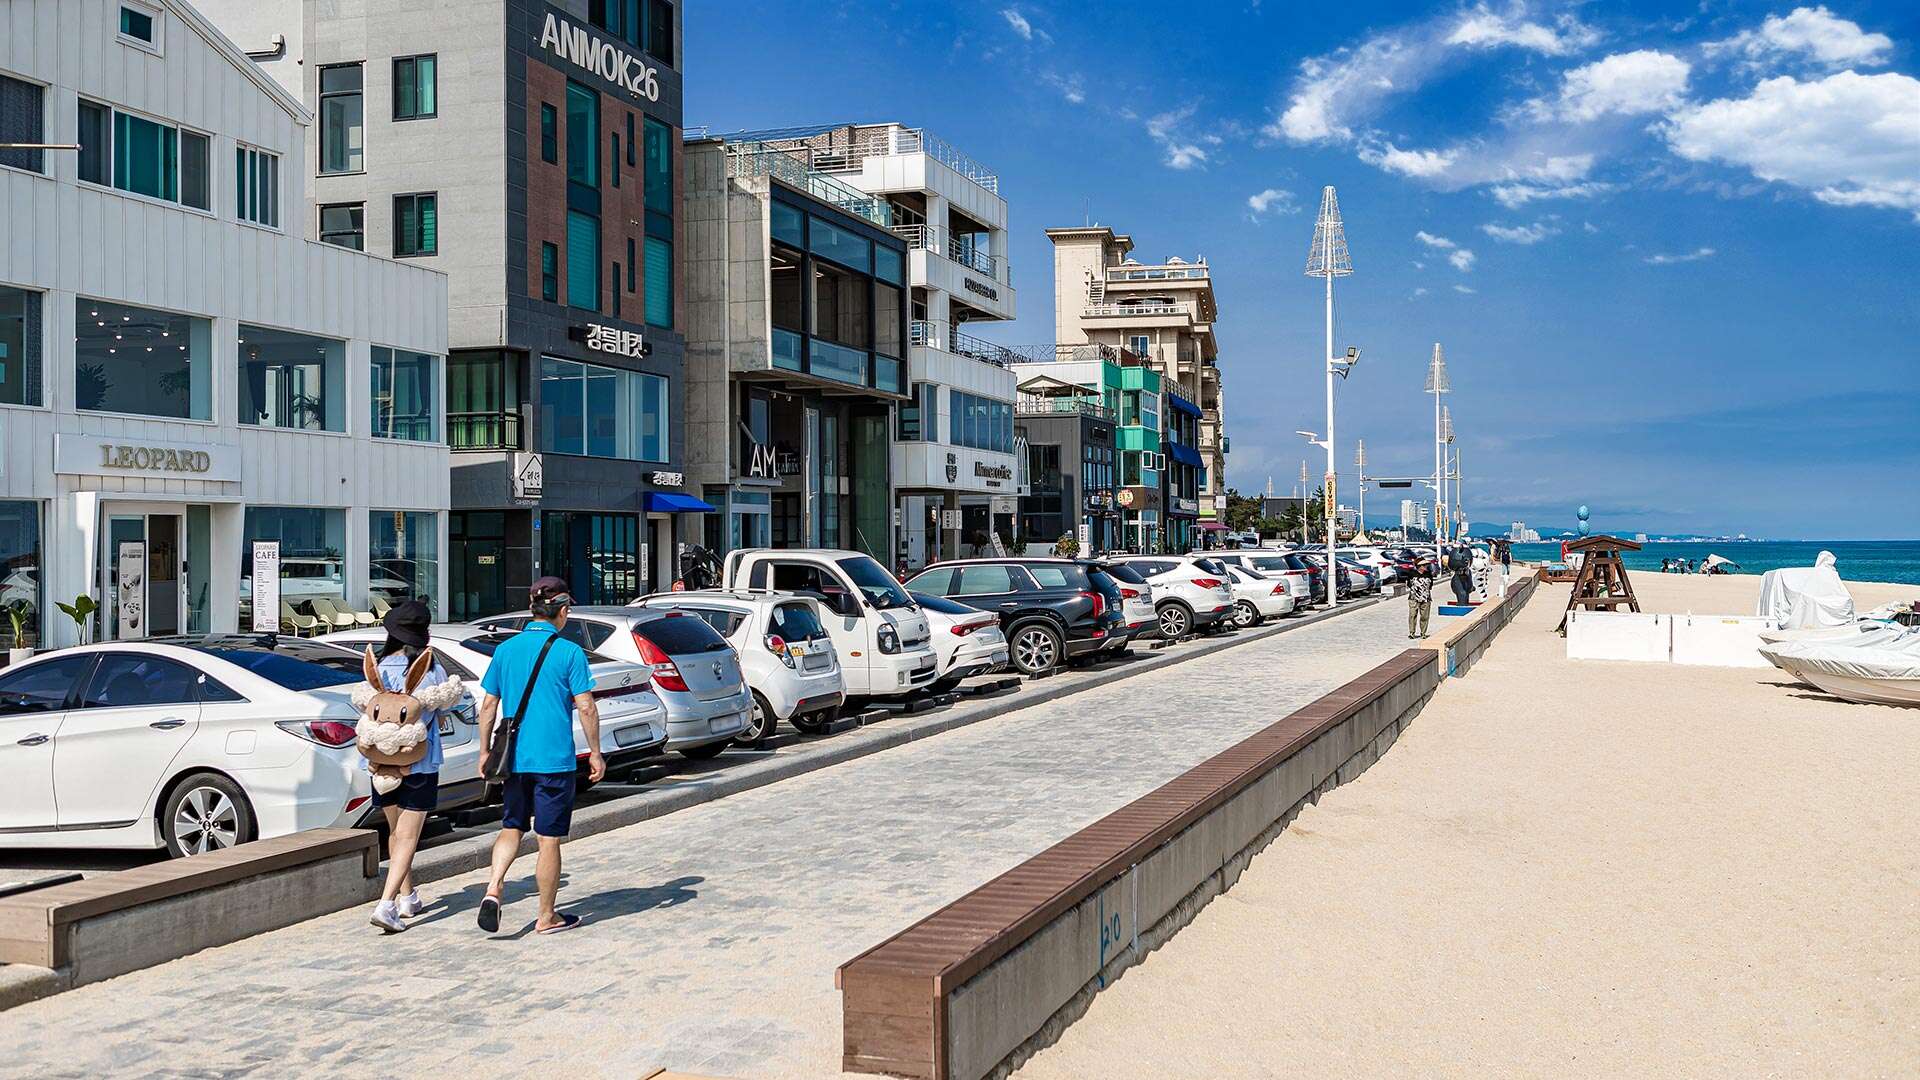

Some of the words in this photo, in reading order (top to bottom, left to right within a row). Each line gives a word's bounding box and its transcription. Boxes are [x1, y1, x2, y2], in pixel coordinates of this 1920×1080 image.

[540, 12, 659, 102] ANMOK26
[586, 323, 644, 359] 강릉네컷
[99, 444, 211, 473] LEOPARD
[750, 443, 777, 478] AM
[255, 551, 277, 560] CAFE
